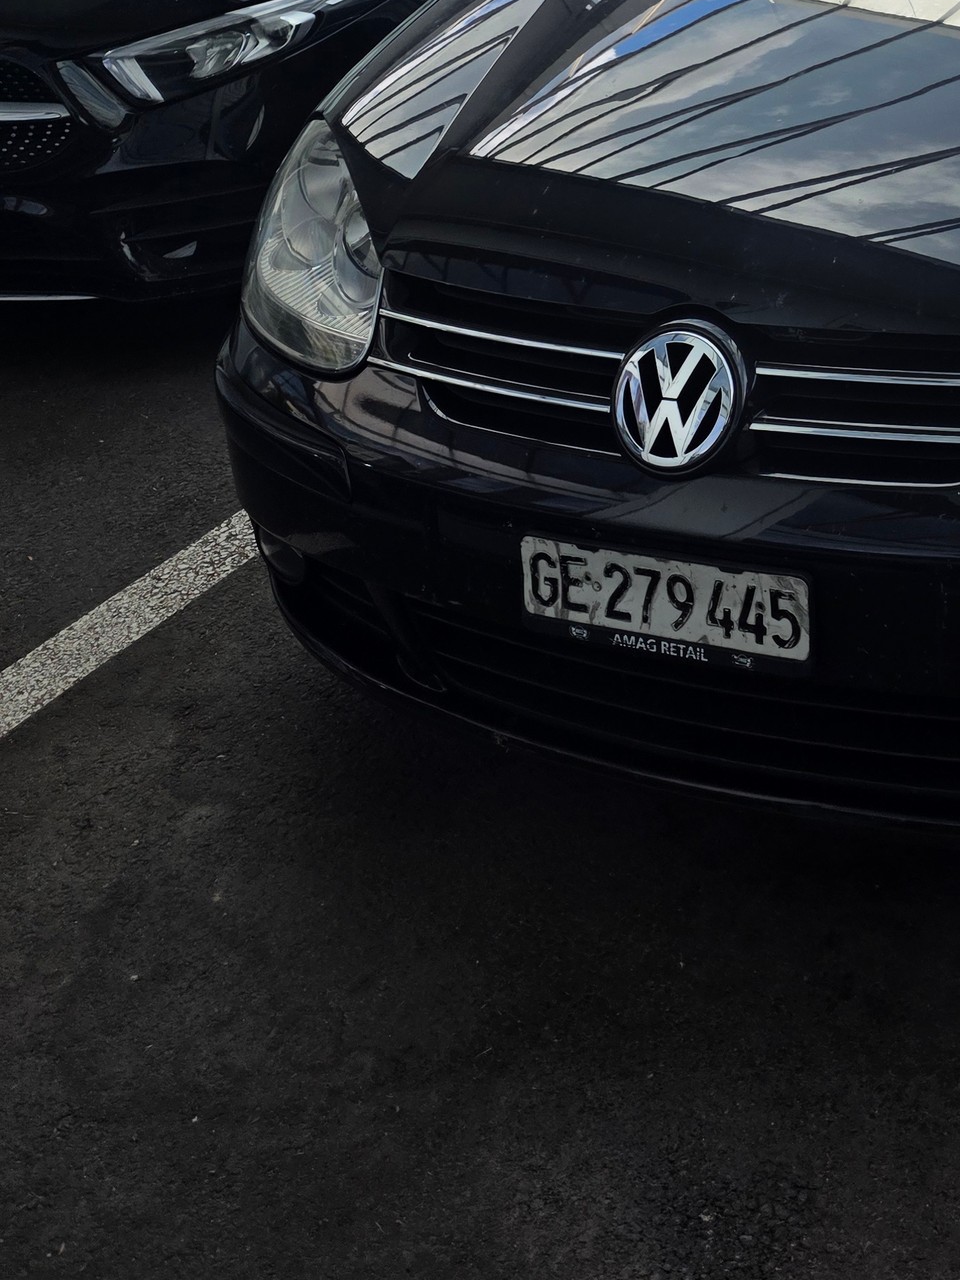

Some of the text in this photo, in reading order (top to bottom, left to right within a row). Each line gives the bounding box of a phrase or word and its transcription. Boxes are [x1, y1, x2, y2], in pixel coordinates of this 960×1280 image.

[603, 561, 695, 632] 279
[706, 579, 802, 650] 445
[611, 633, 709, 662] AMAG RETAIL
